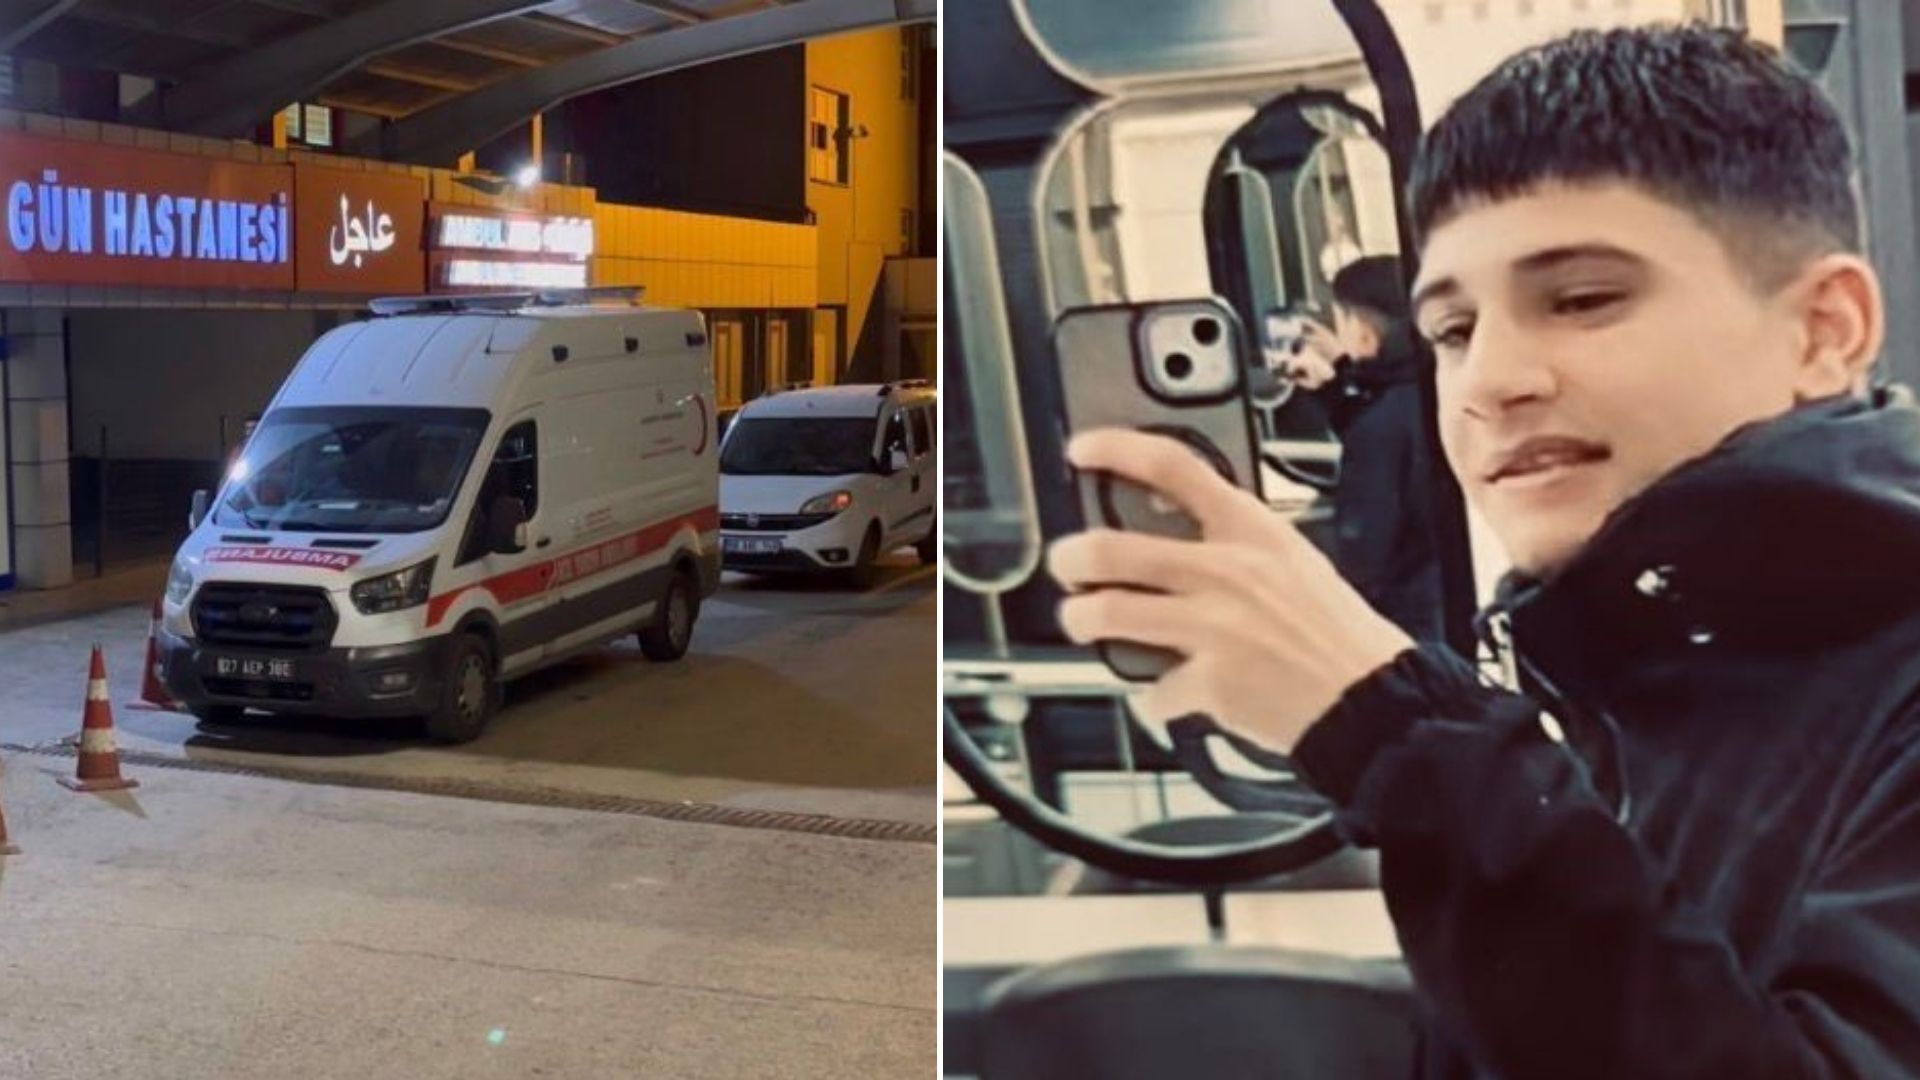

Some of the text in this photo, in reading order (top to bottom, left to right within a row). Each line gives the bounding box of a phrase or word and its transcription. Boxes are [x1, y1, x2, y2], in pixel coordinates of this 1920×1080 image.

[8, 169, 288, 264] GÜN HASTANESİ
[330, 193, 396, 268] عاجل
